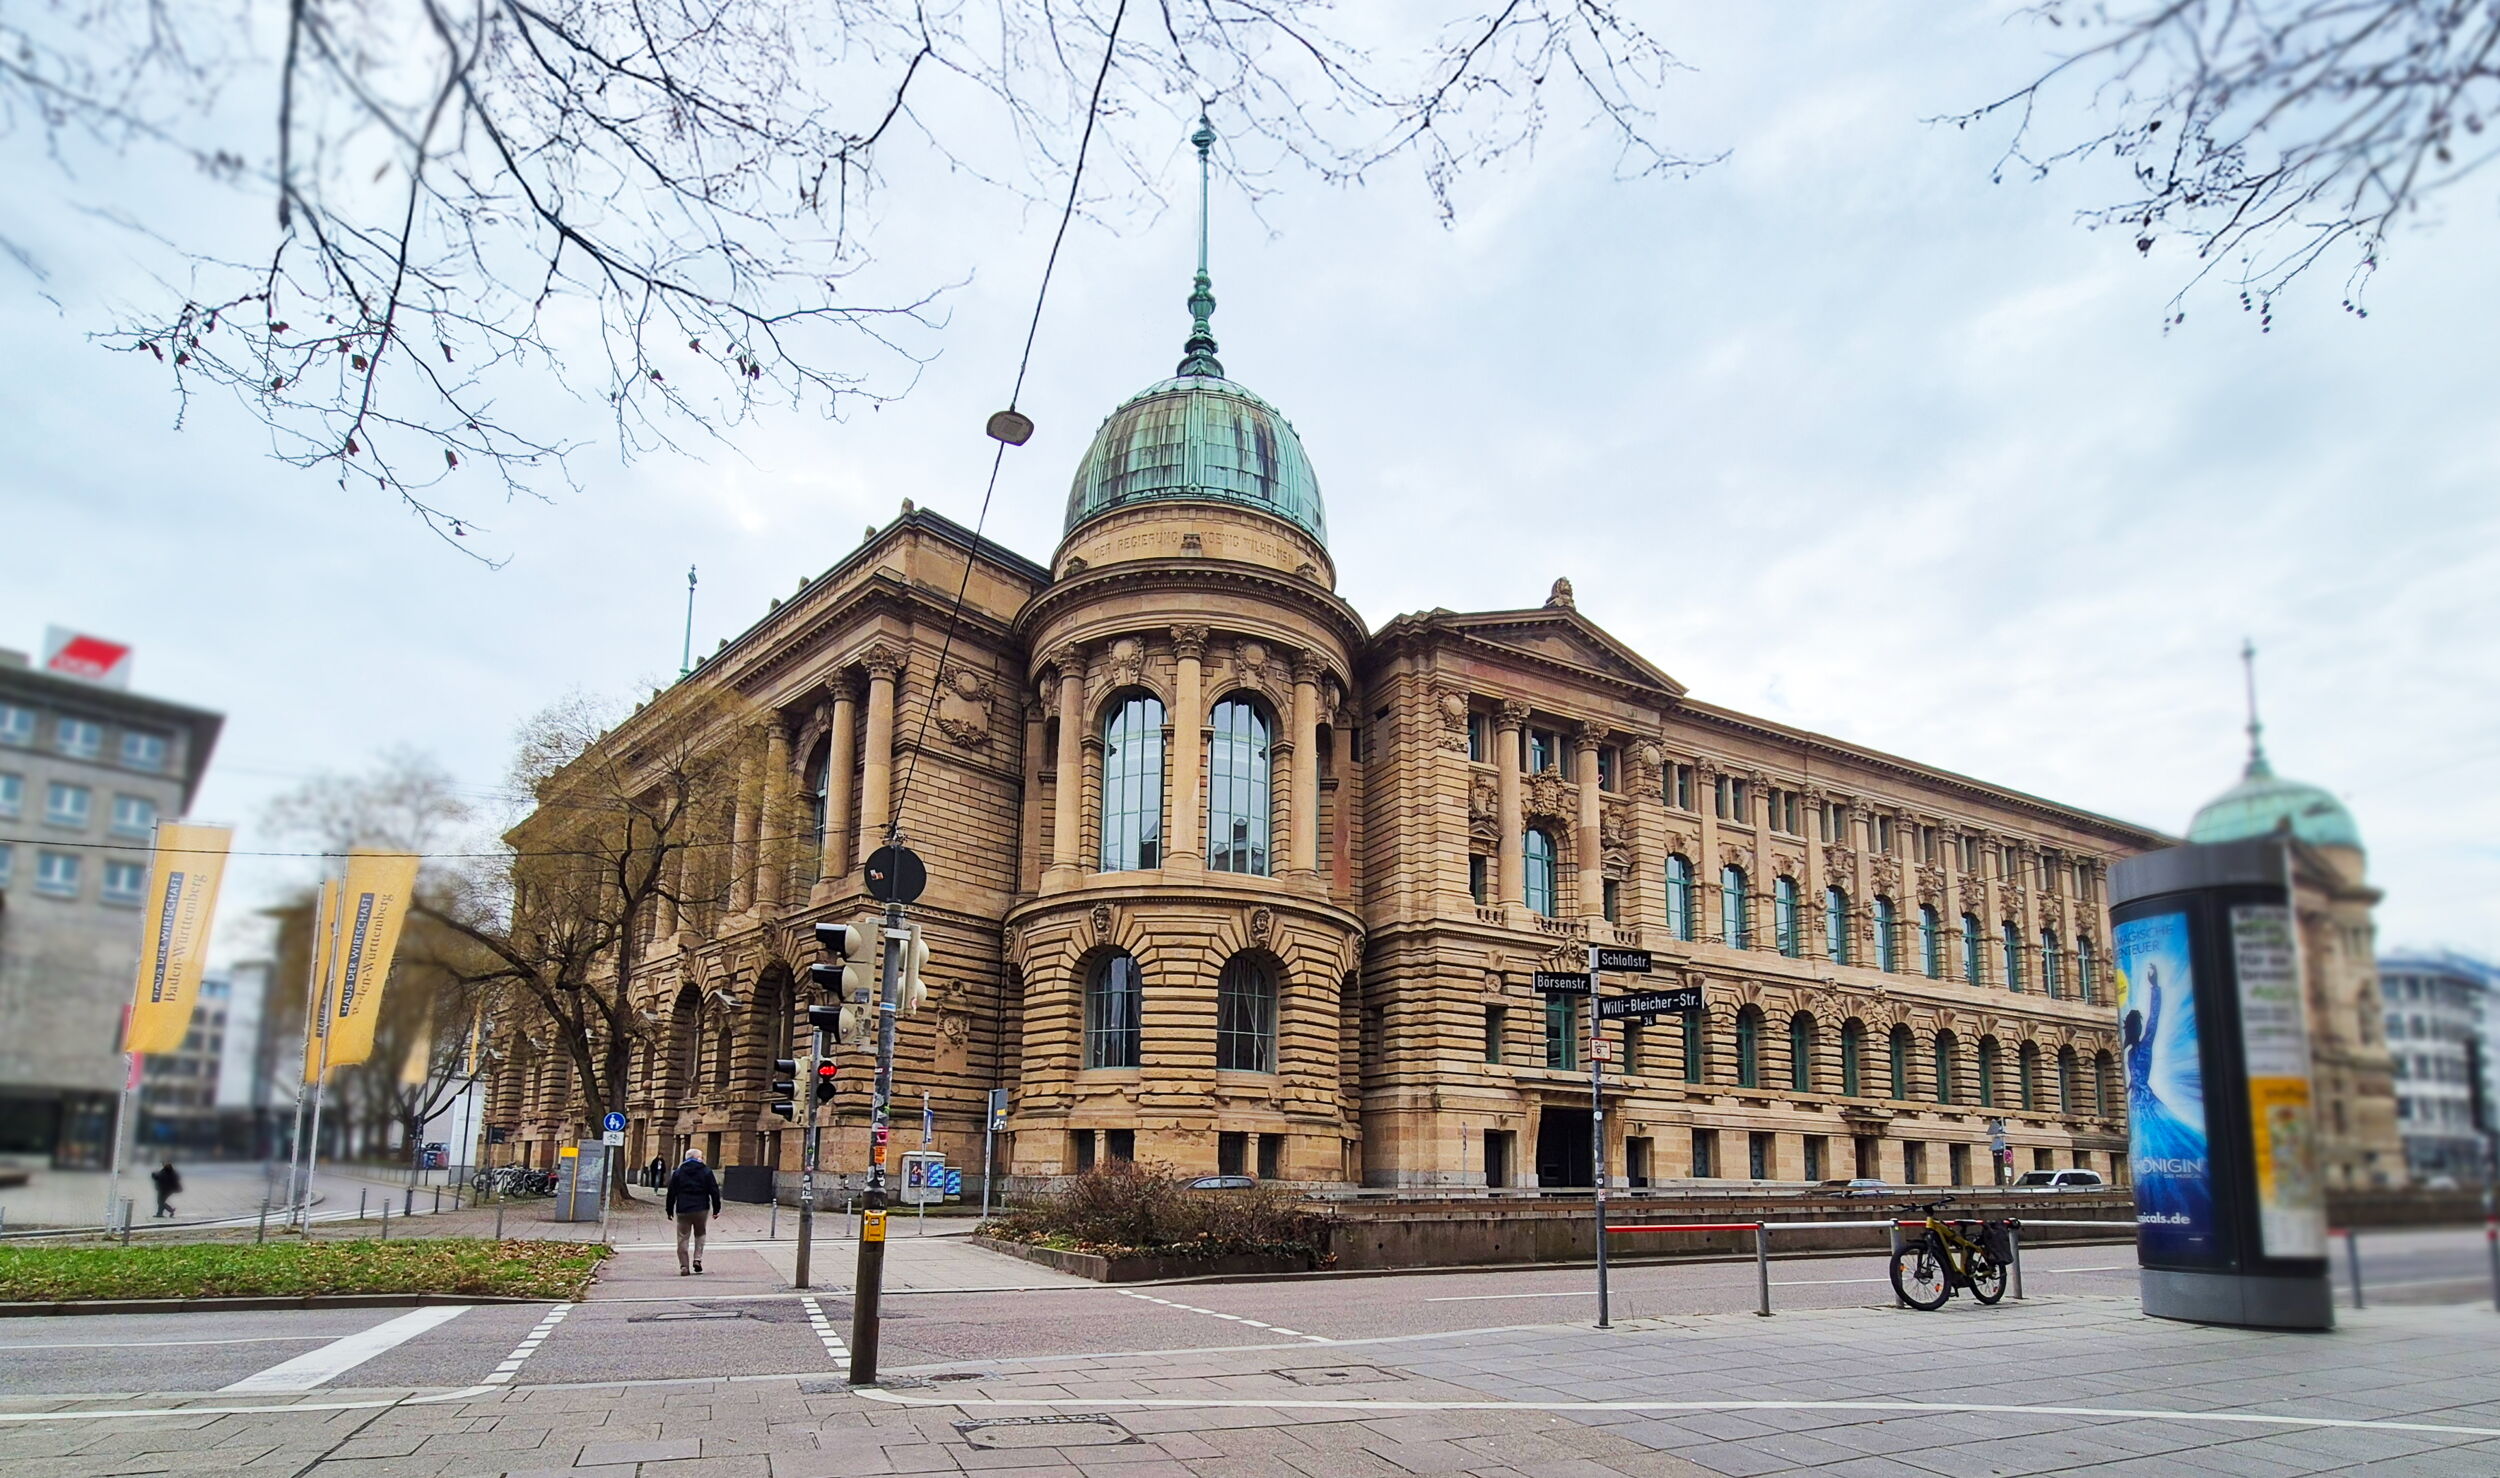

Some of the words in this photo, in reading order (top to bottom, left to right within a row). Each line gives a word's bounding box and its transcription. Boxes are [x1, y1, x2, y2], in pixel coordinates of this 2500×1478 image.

[1118, 531, 1178, 552] REGIERUNG
[163, 873, 208, 1002] Baden-Württemberg
[351, 896, 371, 959] WIRTSCHAFT
[1601, 953, 1649, 968] Schloßstr.
[347, 962, 357, 981] DER
[1537, 975, 1588, 991] Börsenstr.
[341, 984, 353, 1013] HAUS
[1602, 993, 1699, 1015] Willi-Bleicher-Str.
[1643, 1017, 1653, 1026] 34
